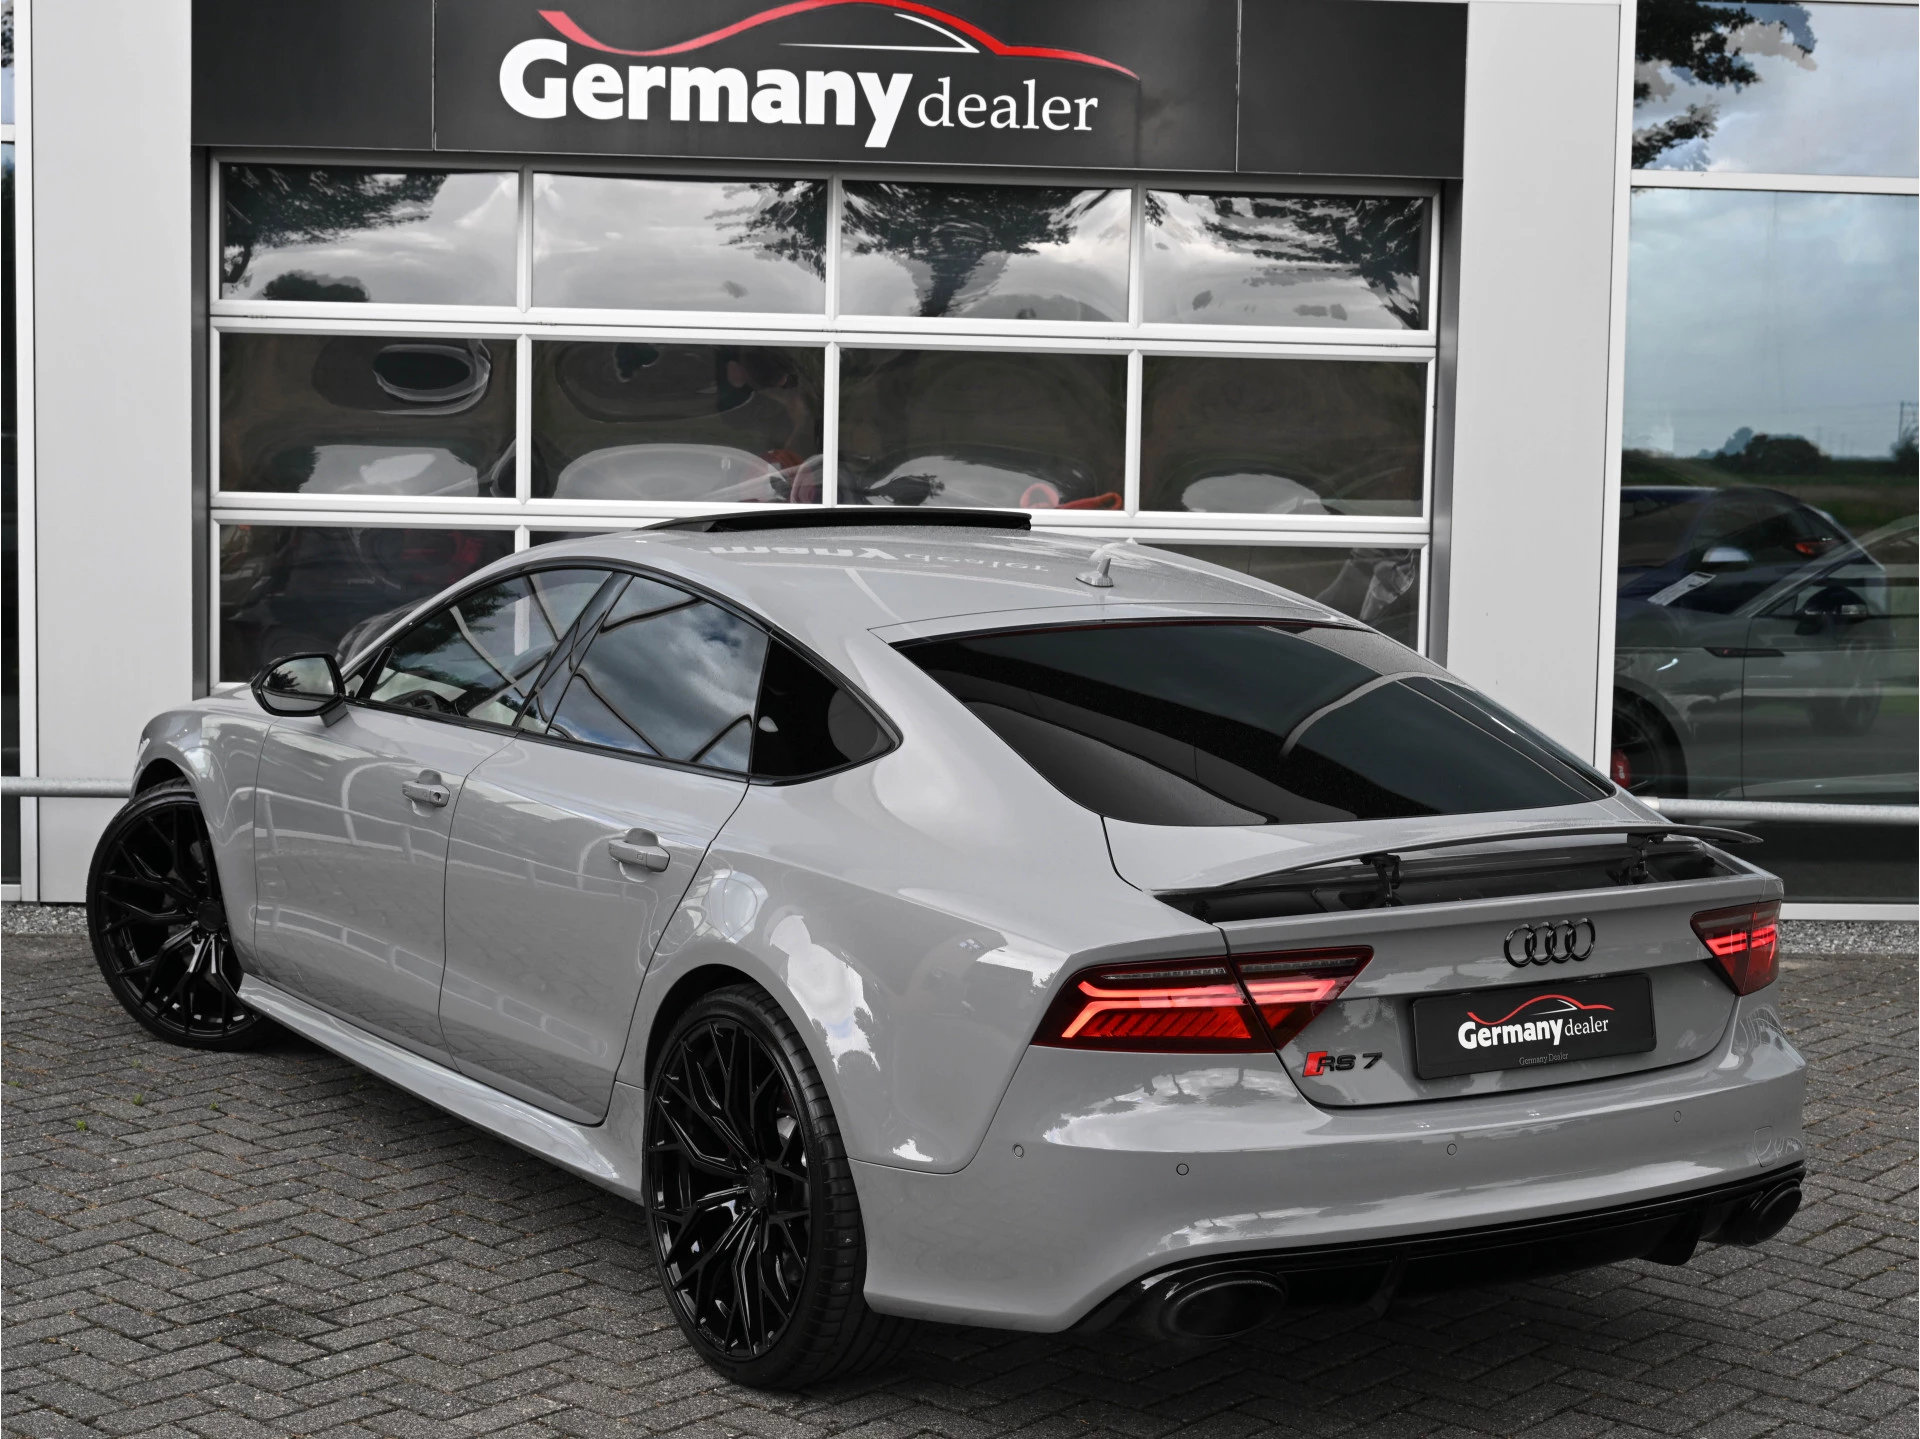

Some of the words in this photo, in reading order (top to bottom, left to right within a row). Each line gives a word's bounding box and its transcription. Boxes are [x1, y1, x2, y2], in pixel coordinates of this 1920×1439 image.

[499, 38, 914, 148] Germany
[917, 76, 1098, 131] dealer
[1457, 1018, 1564, 1050] Germany
[1564, 1015, 1609, 1036] dealer
[1314, 1053, 1357, 1073] RS
[1362, 1051, 1383, 1070] 7
[1518, 1054, 1548, 1066] Germany
[1548, 1052, 1569, 1062] Dealer
